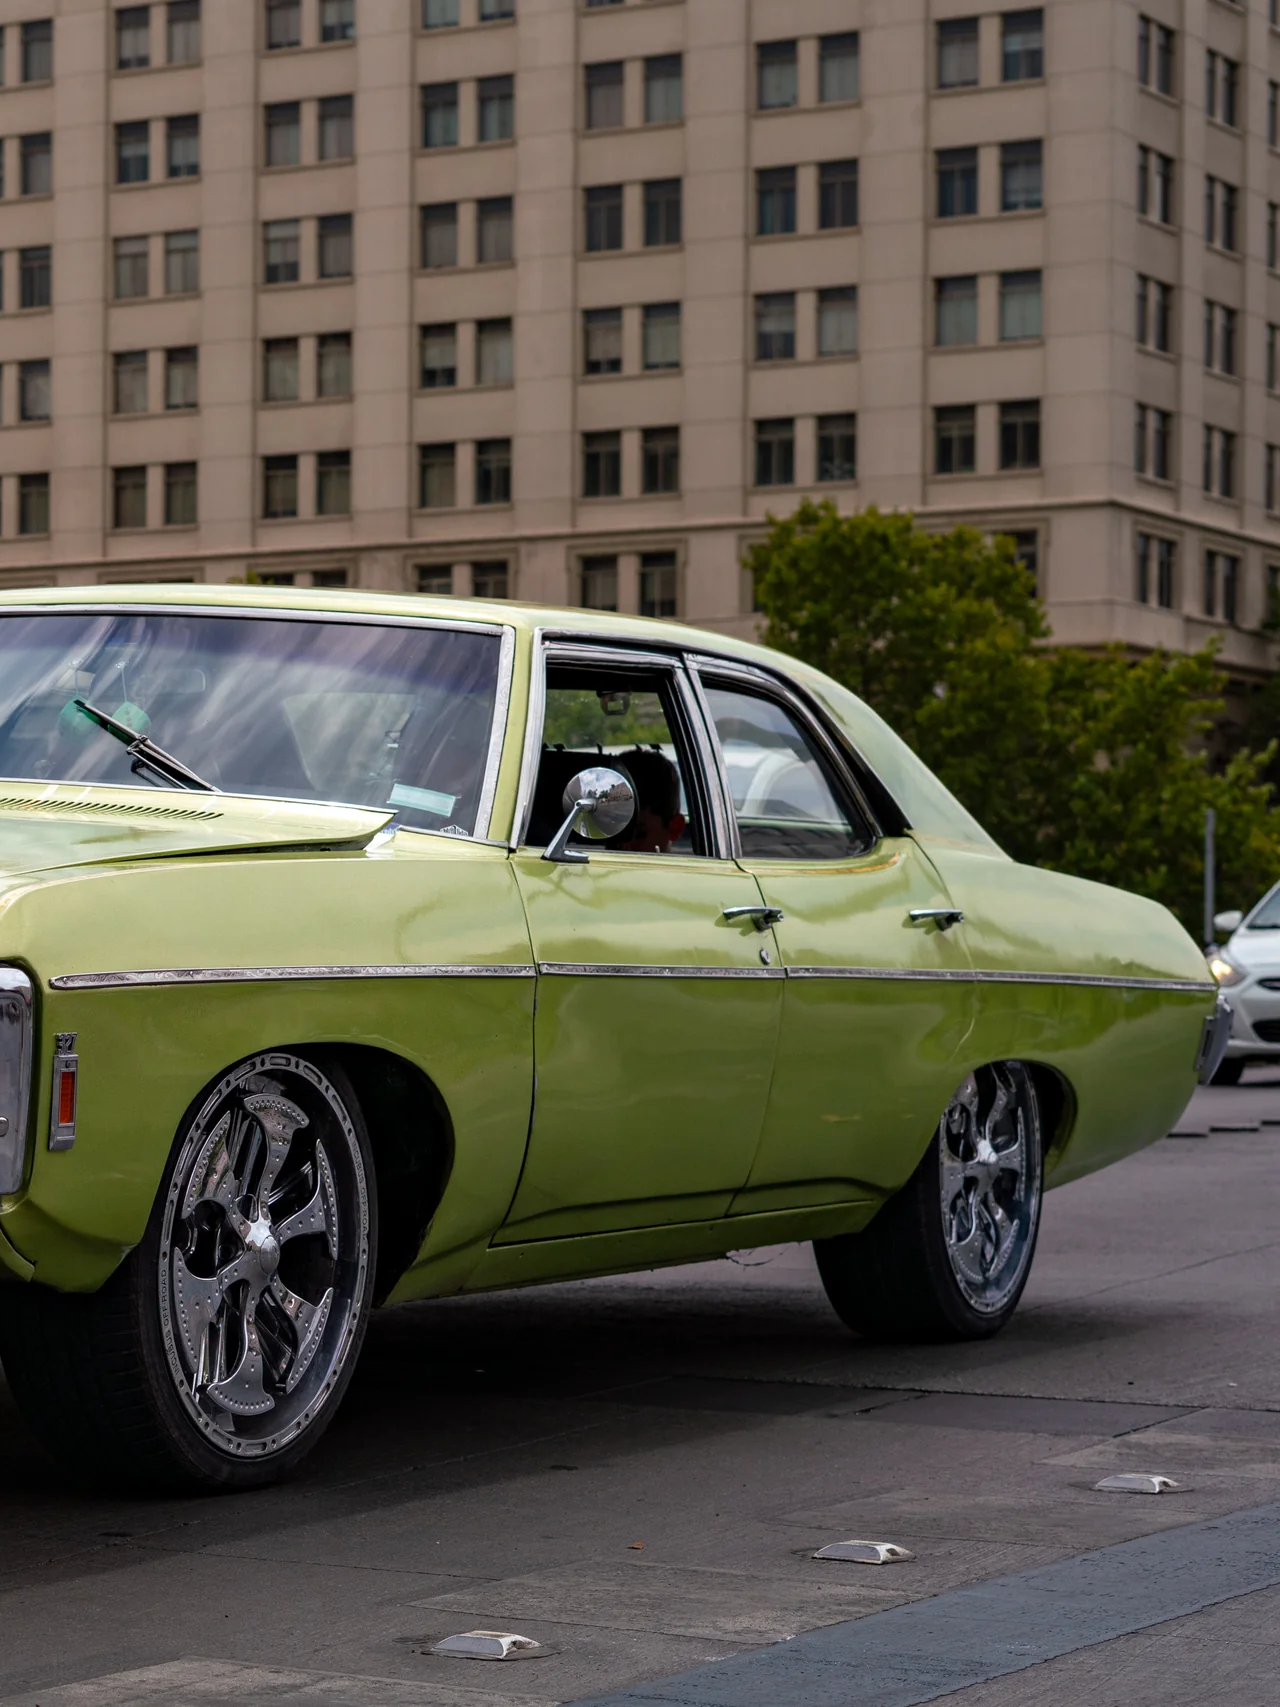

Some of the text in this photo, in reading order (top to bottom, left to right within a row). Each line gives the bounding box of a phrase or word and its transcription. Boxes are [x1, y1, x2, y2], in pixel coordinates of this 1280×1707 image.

[55, 1032, 78, 1055] 327
[352, 1140, 365, 1184] INCUBUS
[161, 1269, 180, 1375] INCUBUS OFF-ROAD
